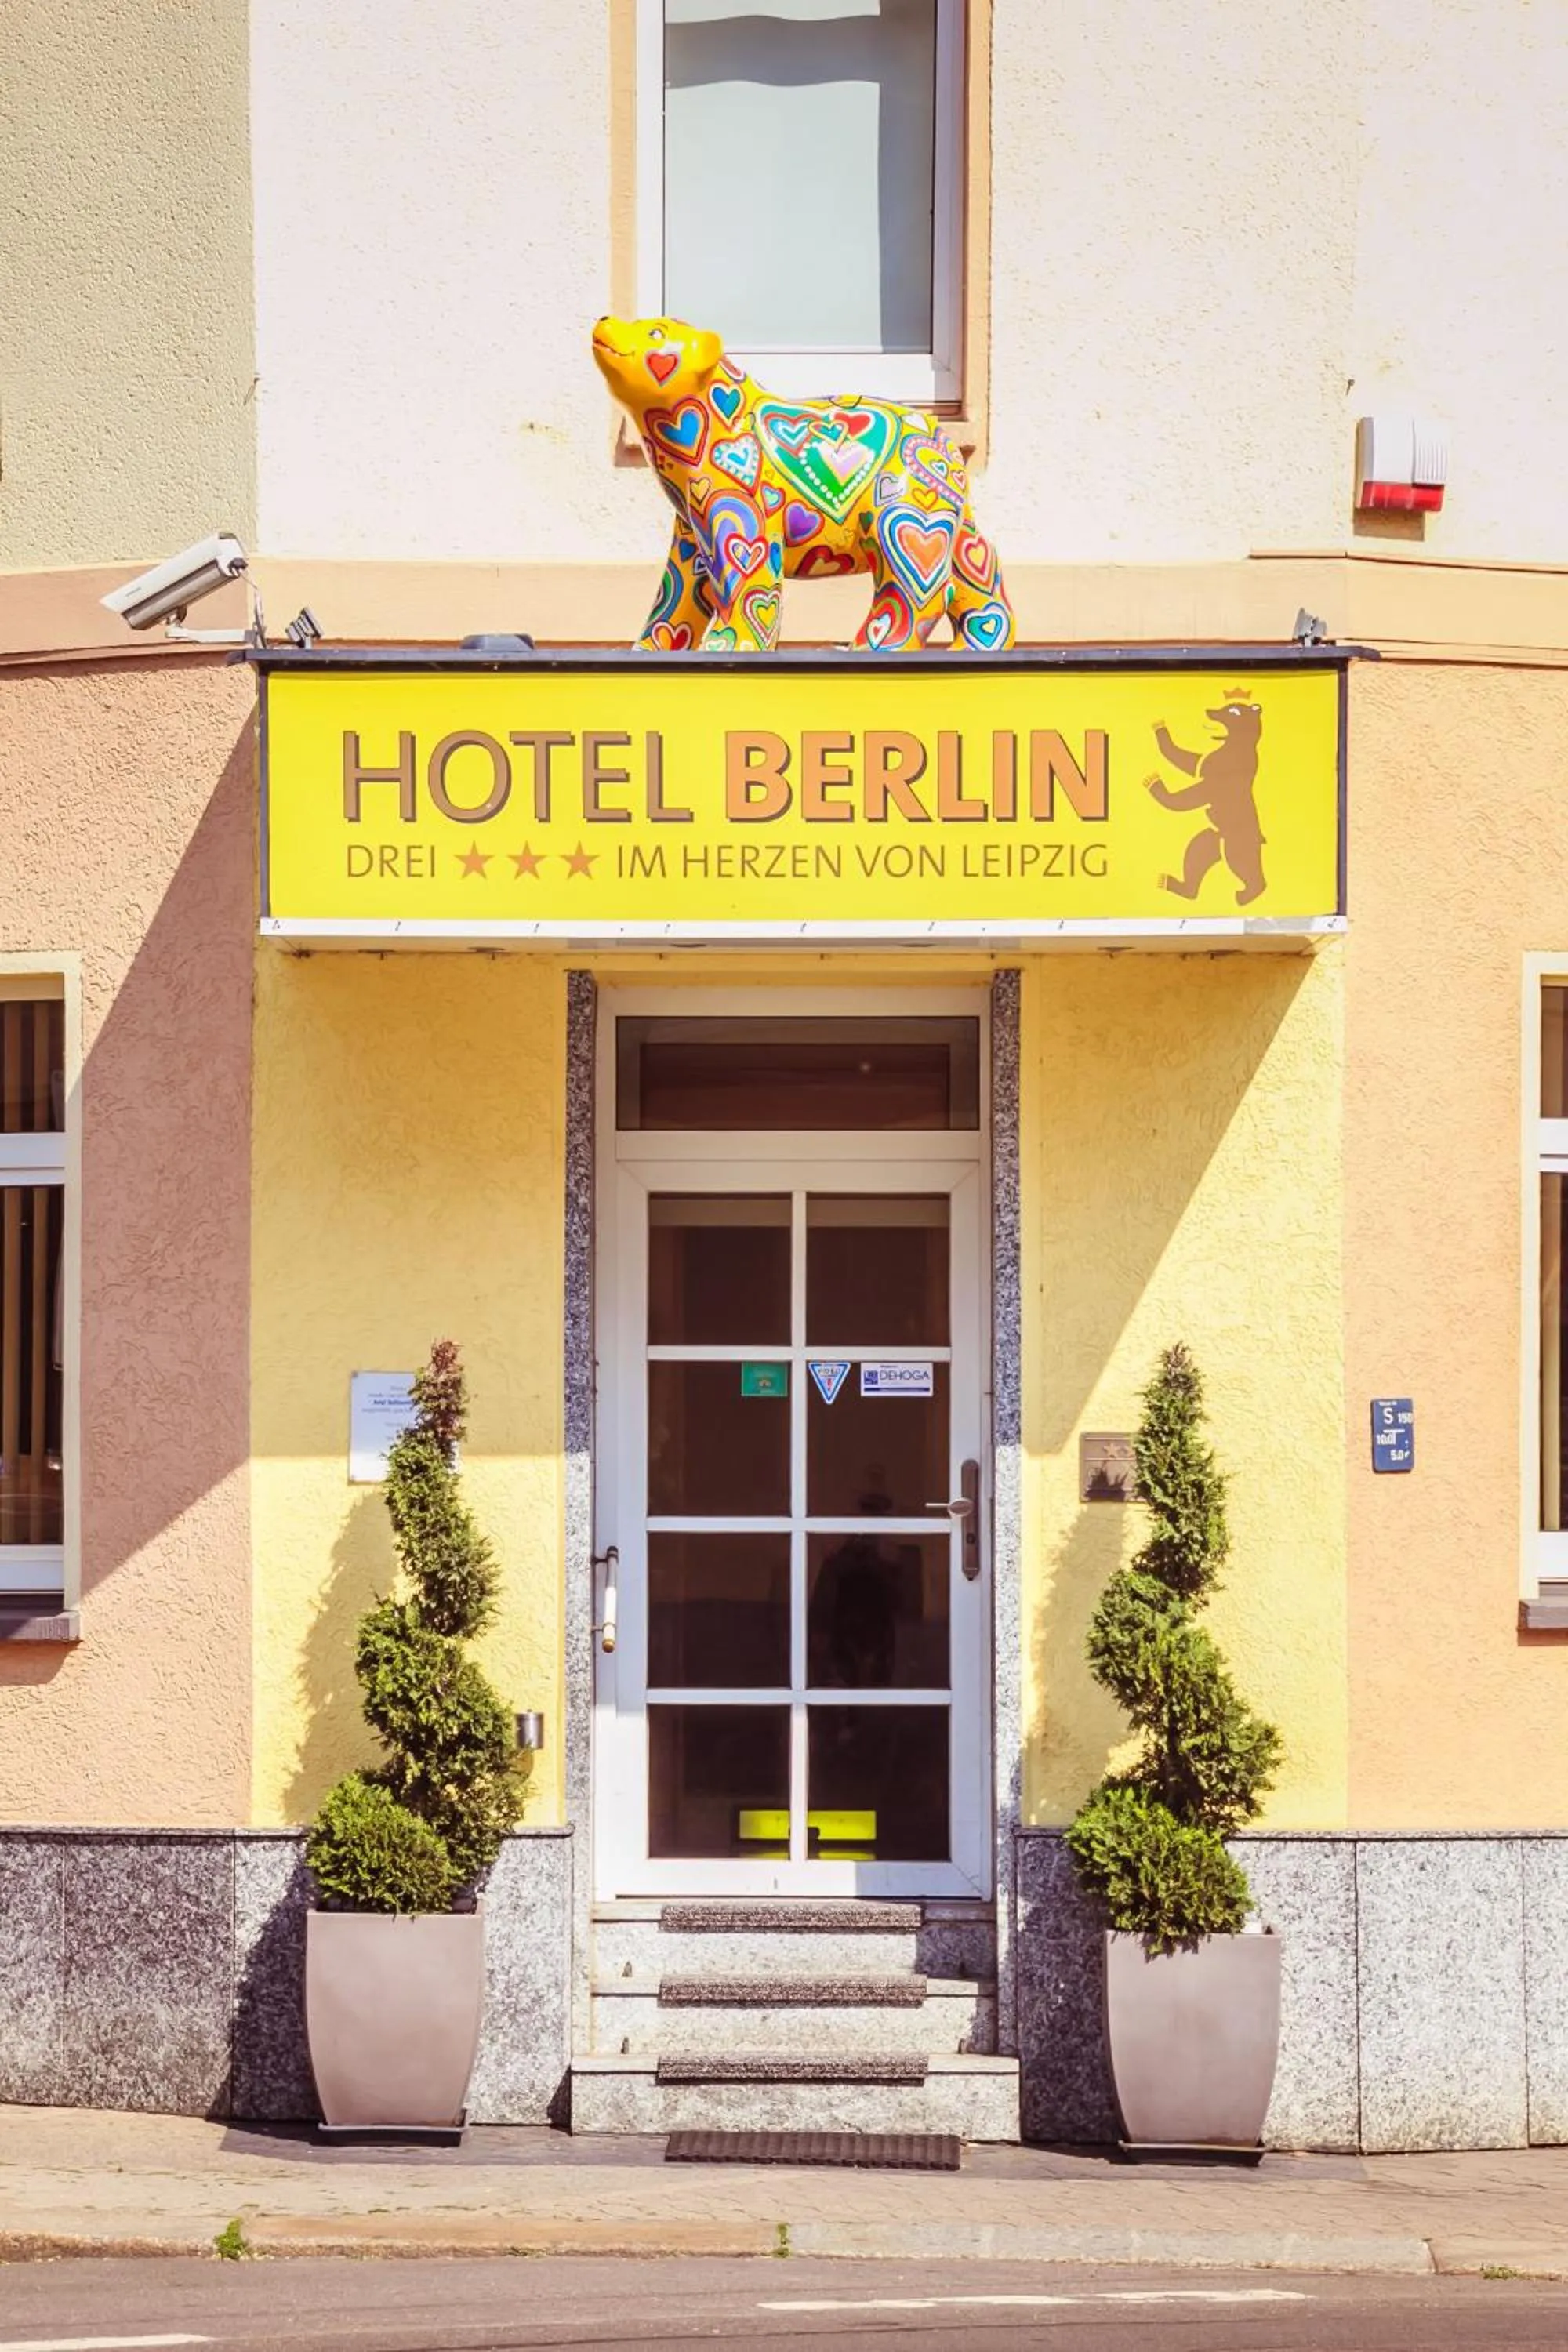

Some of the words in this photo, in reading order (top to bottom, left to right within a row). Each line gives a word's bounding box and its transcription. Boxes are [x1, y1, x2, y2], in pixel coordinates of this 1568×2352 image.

[343, 729, 694, 824] HOTEL
[724, 729, 1109, 824] BERLIN
[347, 844, 435, 877] DREI
[618, 845, 666, 878] IM
[683, 844, 841, 878] HERZEN
[855, 844, 945, 878] VON
[963, 843, 1108, 878] LEIPZIG
[879, 1370, 931, 1381] DEHOGA
[1383, 1407, 1393, 1425] S
